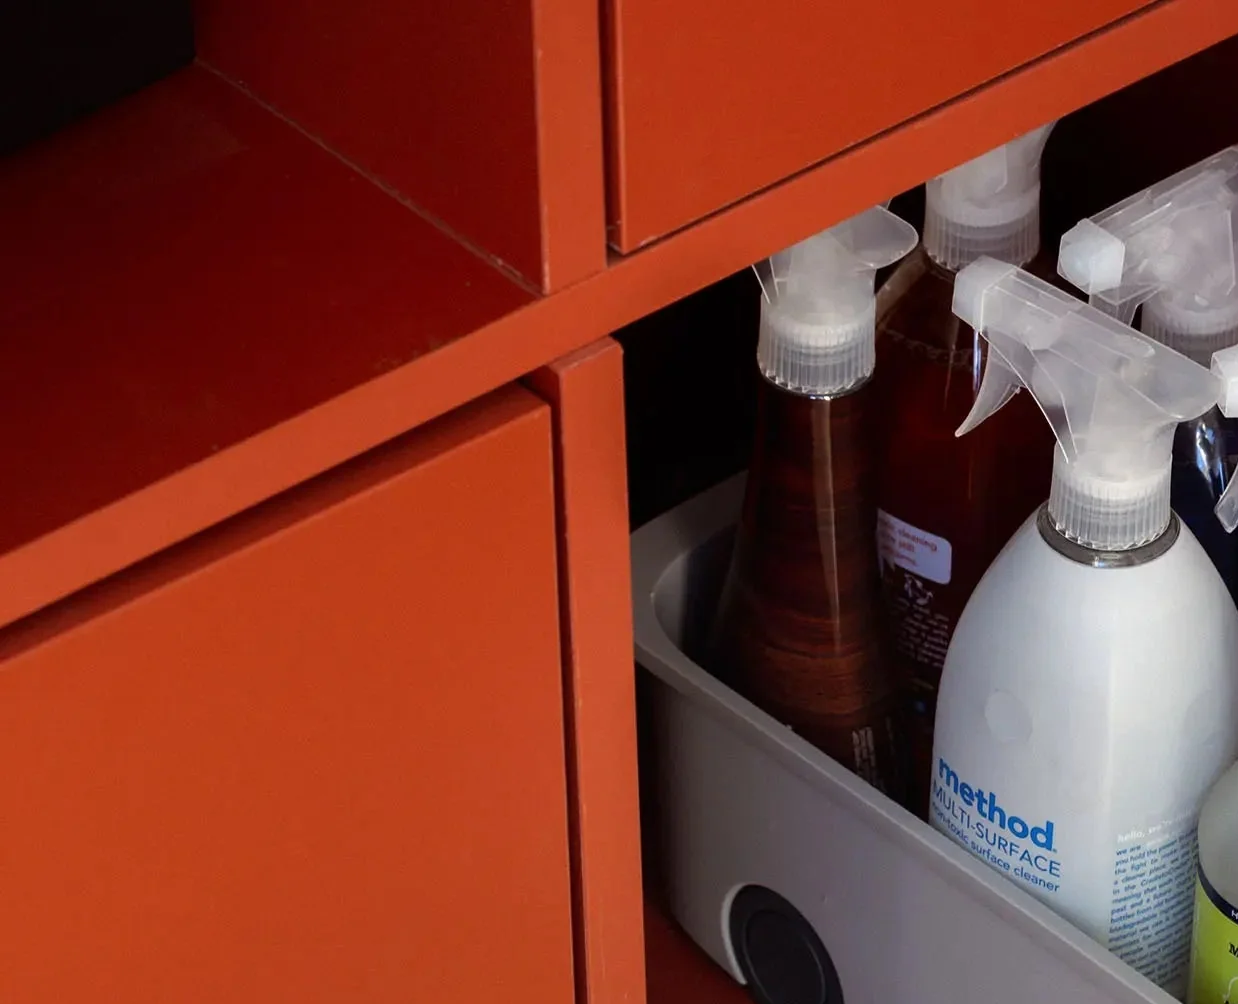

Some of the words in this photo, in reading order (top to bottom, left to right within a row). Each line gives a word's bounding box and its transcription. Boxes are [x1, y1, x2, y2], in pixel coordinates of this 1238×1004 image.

[932, 779, 1061, 878] MULTI-SURFACE
[938, 757, 1055, 852] method
[970, 840, 1011, 872] surface
[1013, 865, 1060, 893] cleaner
